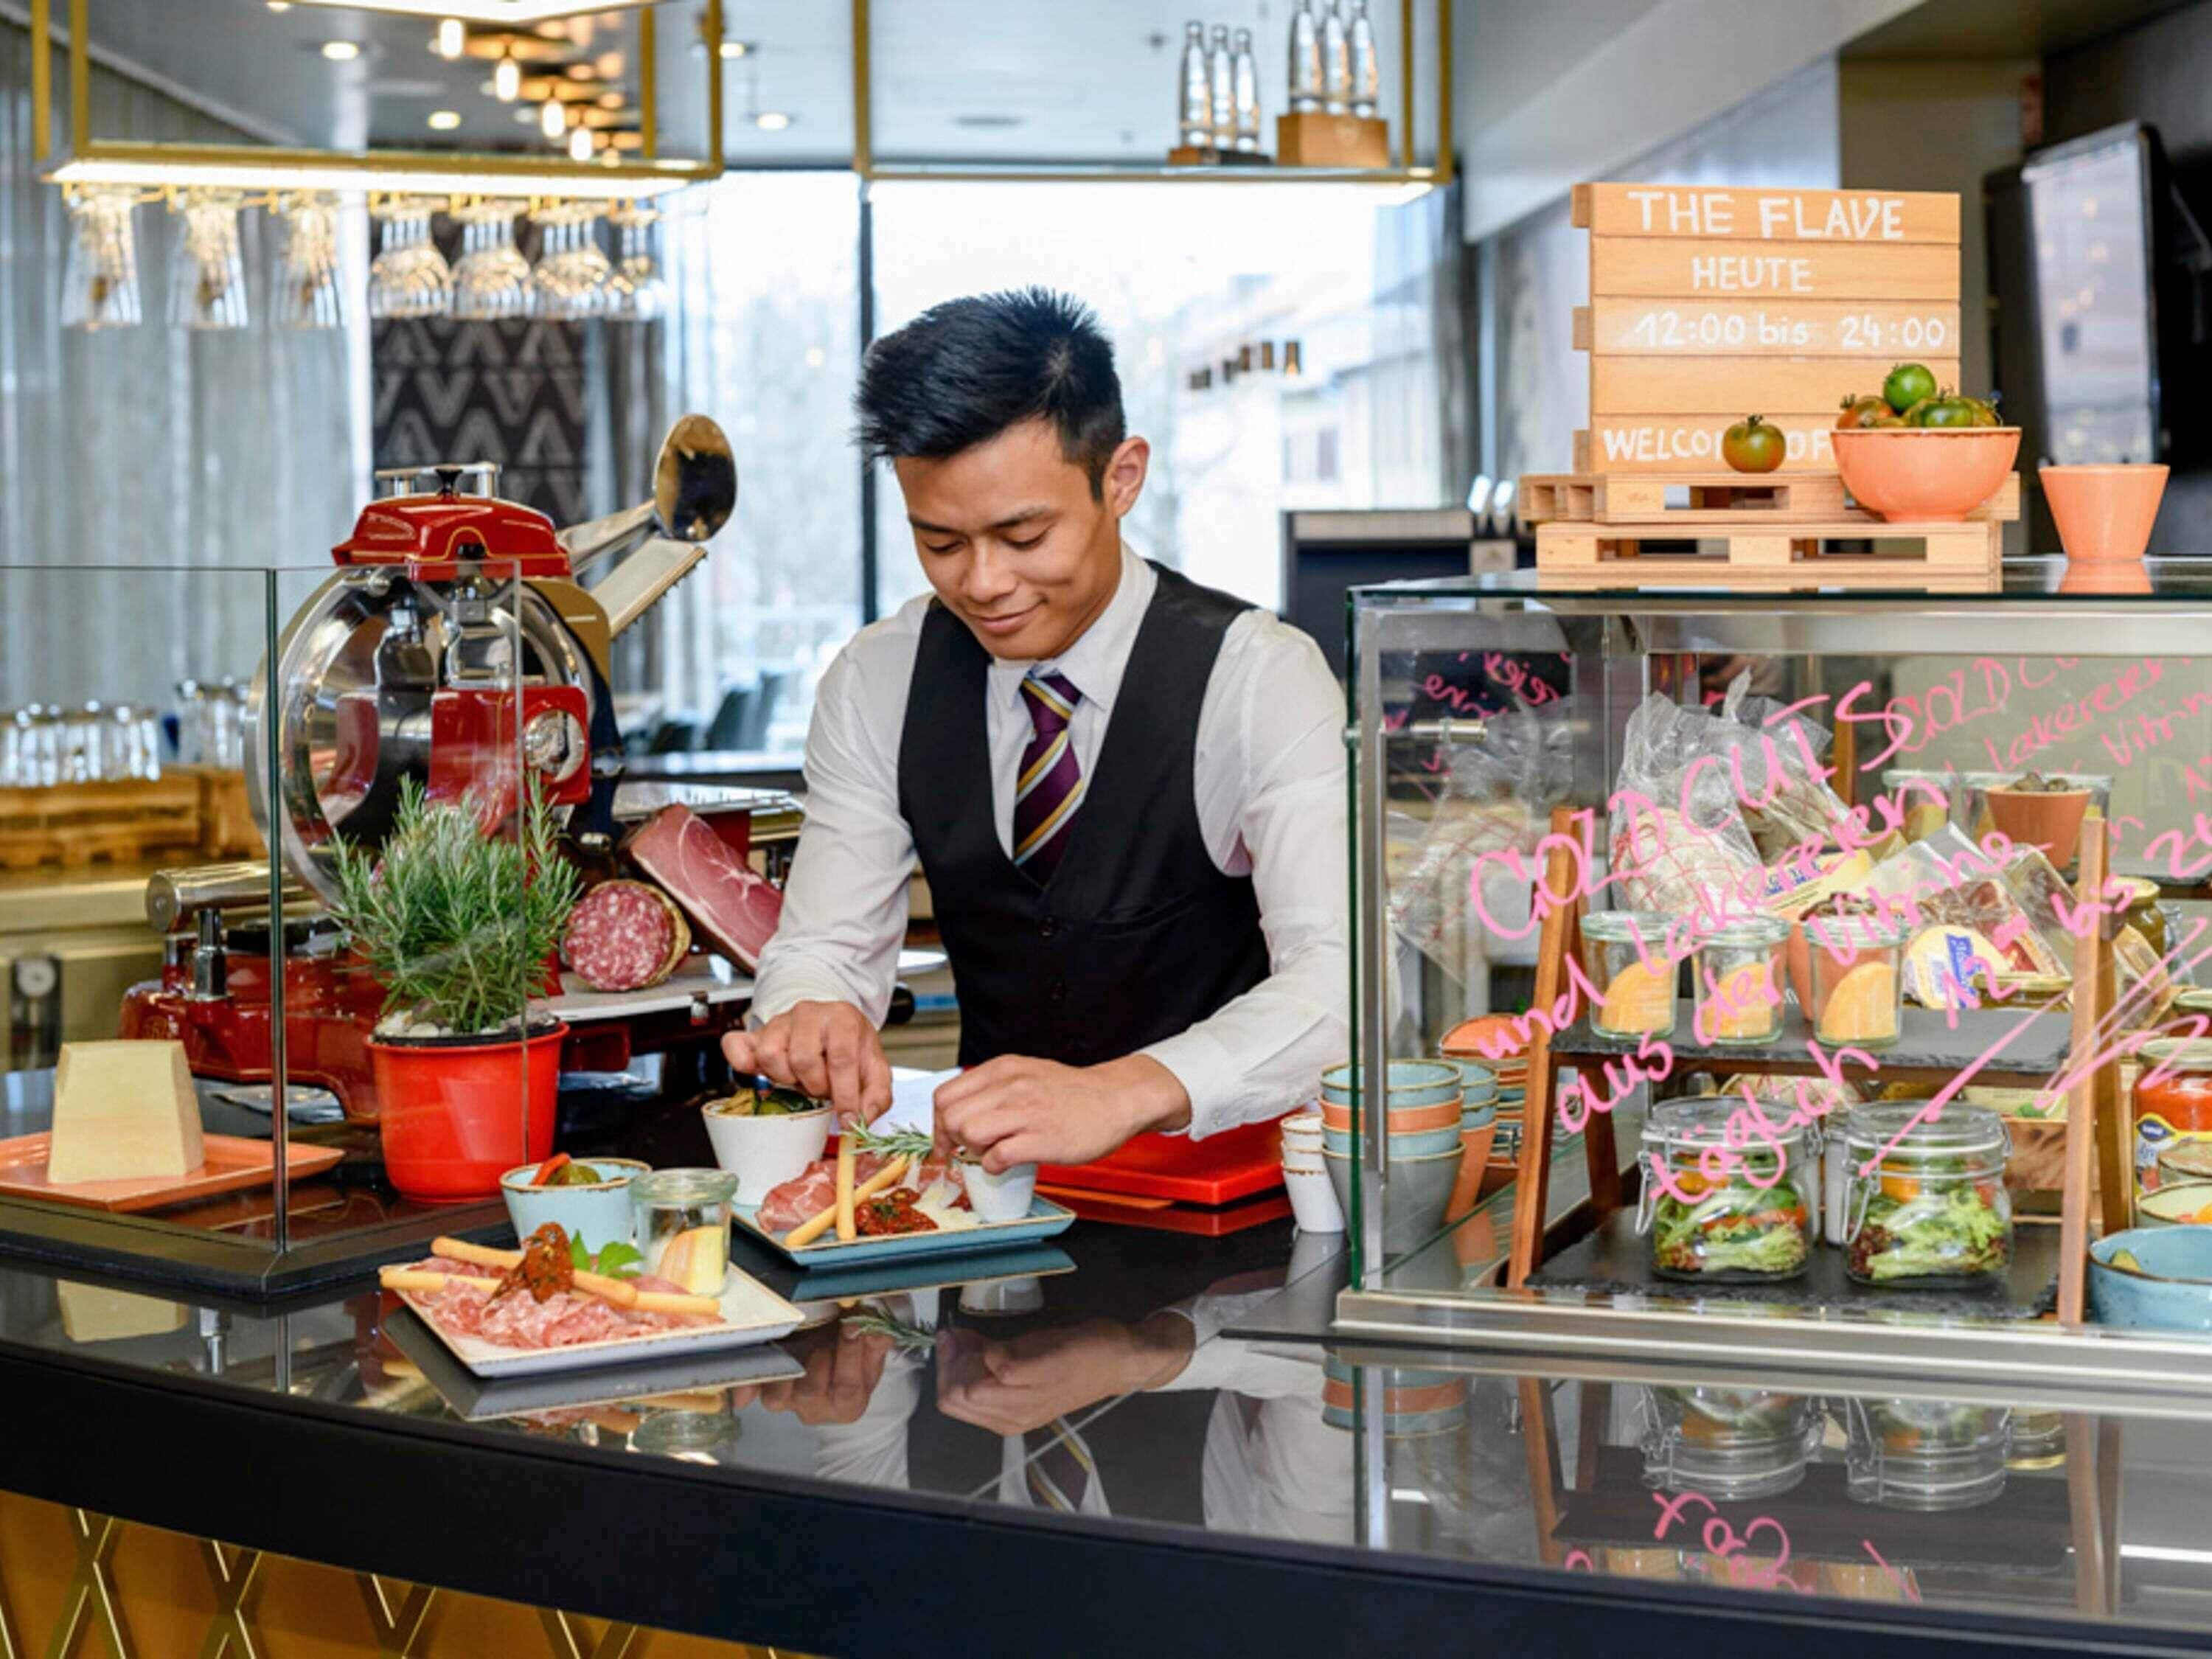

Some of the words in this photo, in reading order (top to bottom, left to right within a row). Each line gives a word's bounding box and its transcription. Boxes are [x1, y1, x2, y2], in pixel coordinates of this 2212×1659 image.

[1627, 191, 1735, 234] THE
[1758, 193, 1906, 240] FLAVE
[1692, 255, 1815, 293] HEUTE
[1634, 310, 1746, 348] 12:00
[1756, 314, 1809, 346] bis
[1840, 316, 1947, 348] 24:00
[1680, 681, 1912, 837] CUTS
[1477, 951, 1609, 1060] und
[1559, 1029, 1674, 1133] aus
